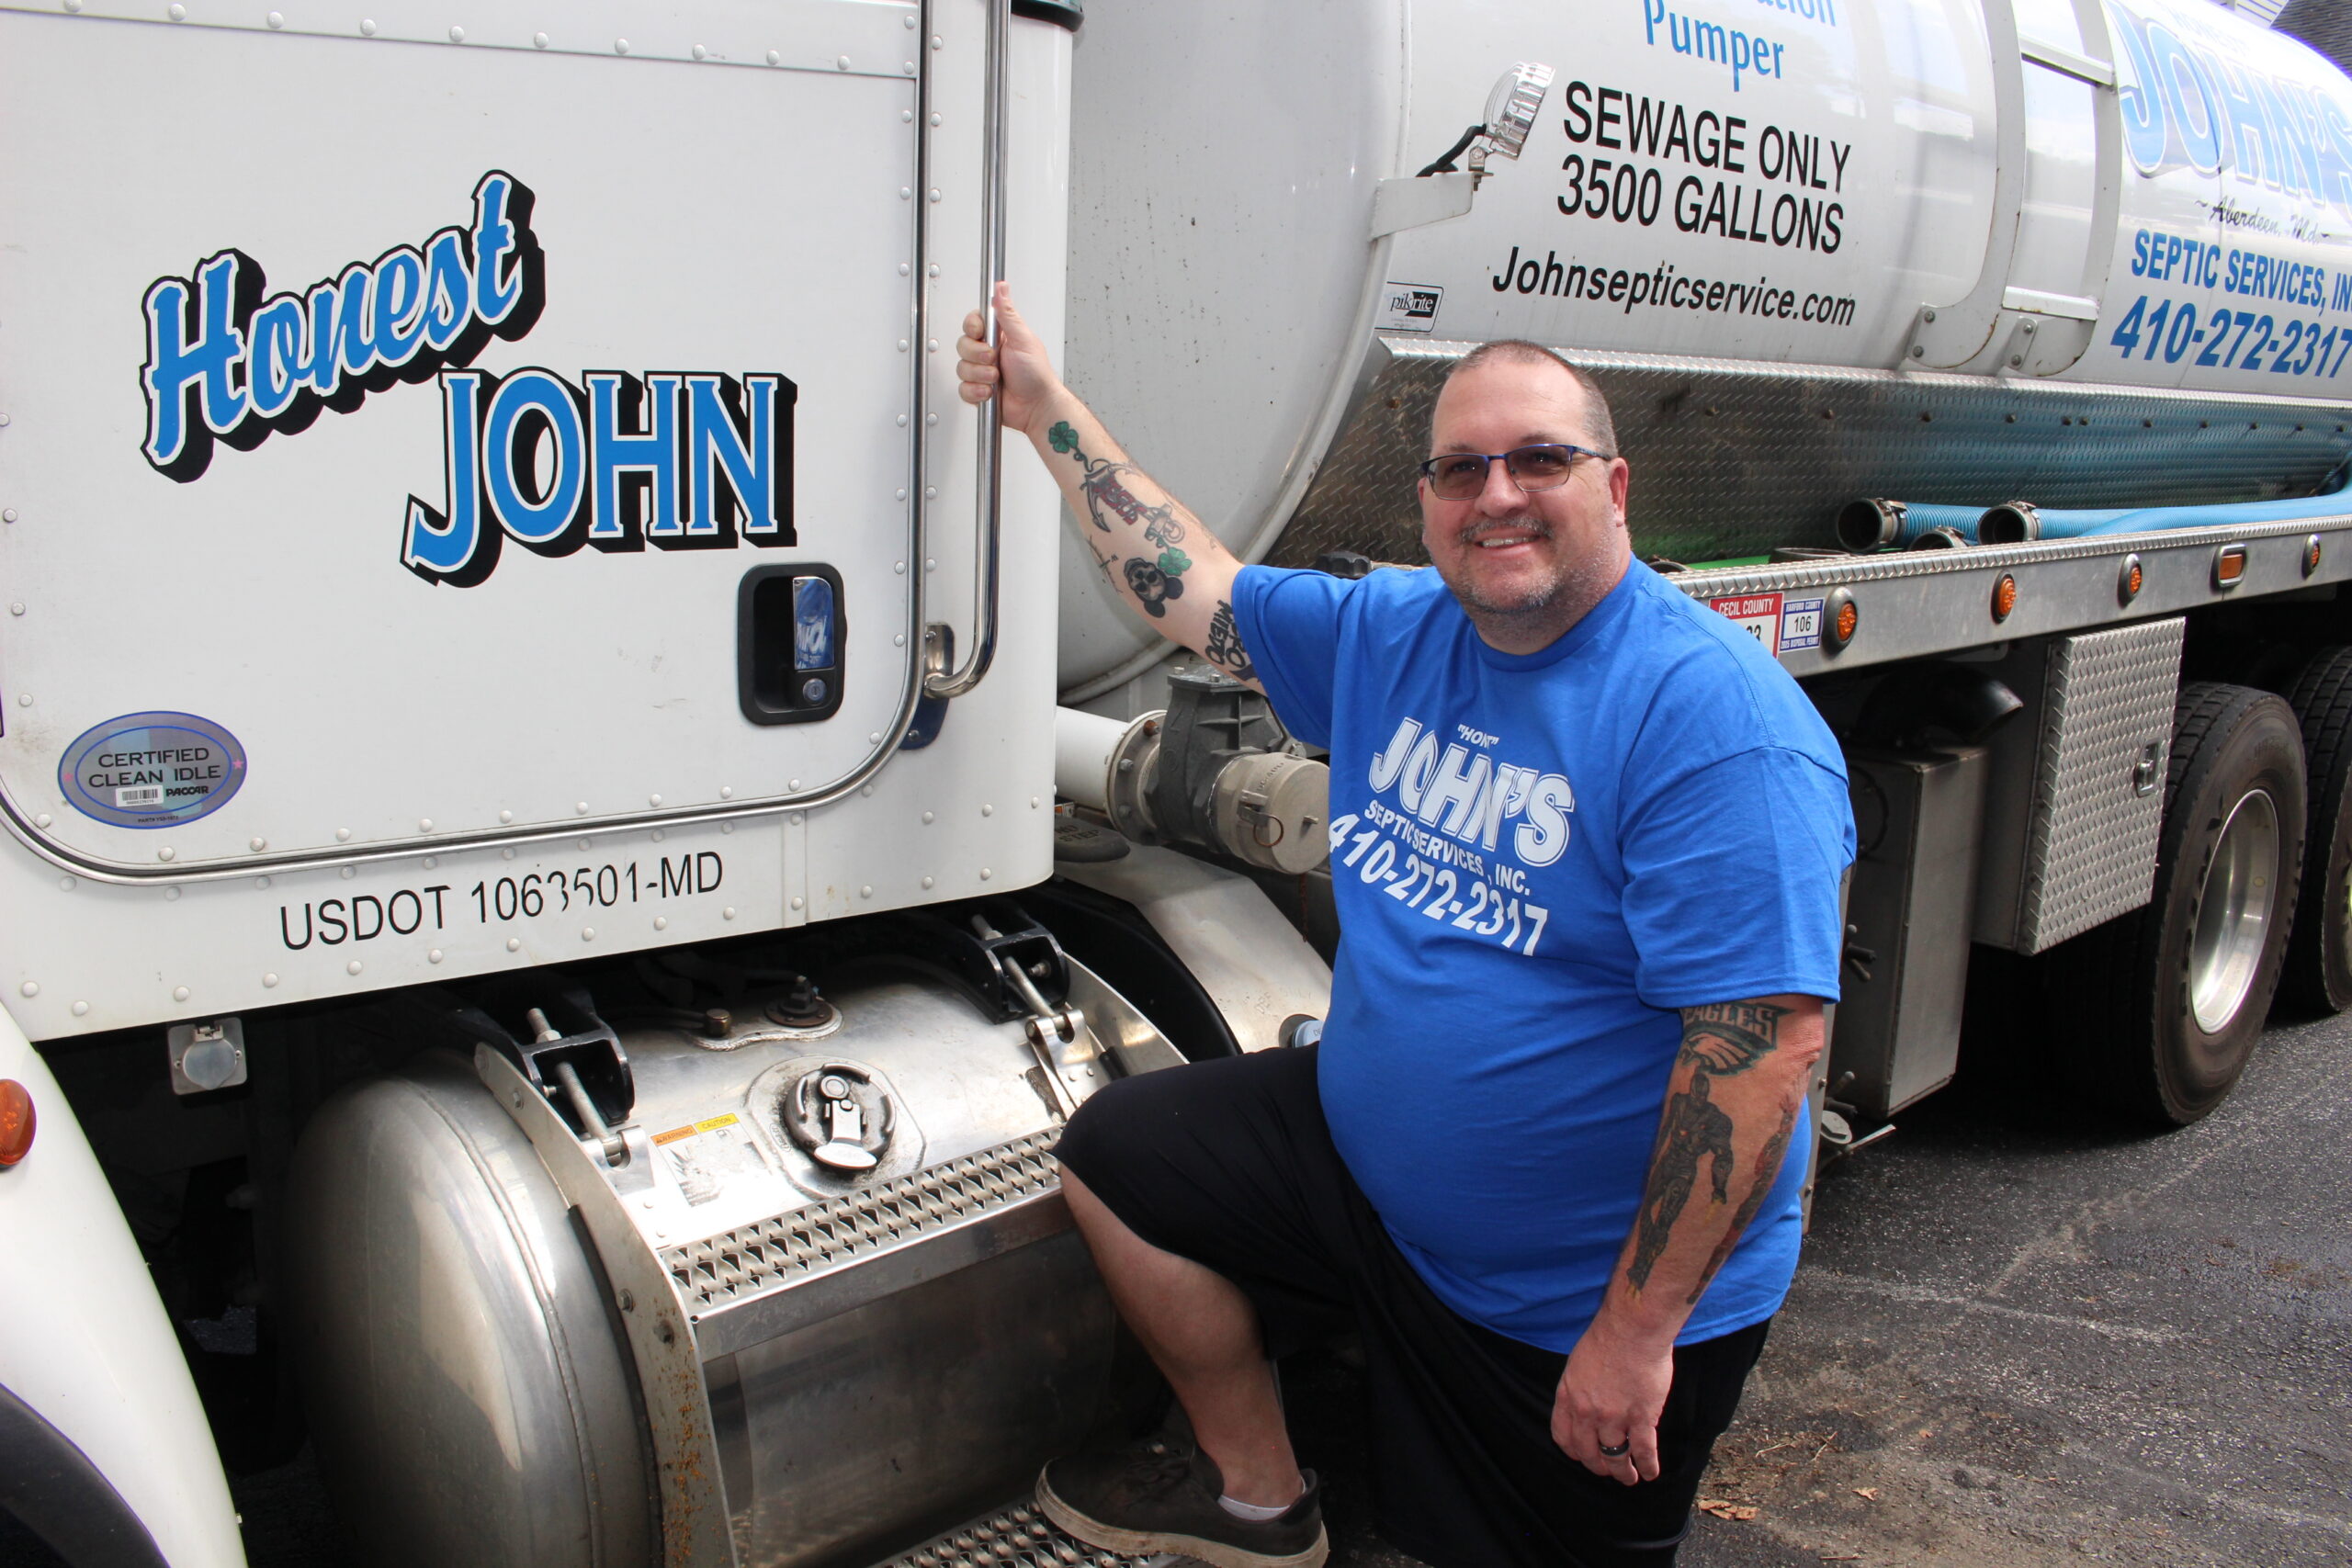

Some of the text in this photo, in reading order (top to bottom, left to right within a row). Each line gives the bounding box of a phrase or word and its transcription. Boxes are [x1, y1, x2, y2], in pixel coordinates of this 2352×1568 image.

[1643, 0, 1785, 92] Pumper
[1563, 81, 1851, 194] SEWAGE ONLY
[1557, 154, 1844, 254] 3500 GALLONS
[1388, 291, 1435, 312] pikrite
[1492, 246, 1856, 326] Johnsepticservice.com
[2132, 229, 2352, 317] SEPTIC SERVICES, IN
[140, 169, 547, 484] Honest
[2110, 295, 2352, 378] 410-272-2317
[399, 365, 798, 588] JOHN
[1718, 598, 1774, 616] CECIL COUNTY
[1794, 615, 1812, 632] 106
[1804, 600, 1821, 611] COUNTY
[88, 765, 221, 787] CLEAN IDLE
[98, 748, 209, 768] CERTIFIED
[165, 785, 209, 797] PACCAR
[1369, 716, 1576, 867] JOHN'S
[1329, 813, 1548, 957] 410-272-2317
[1364, 799, 1414, 841] SEPTIC
[1495, 863, 1531, 897] INC.
[280, 884, 451, 951] USDOT
[1683, 1003, 1774, 1041] EAGLES
[662, 1117, 732, 1143] WARNING CAUTION
